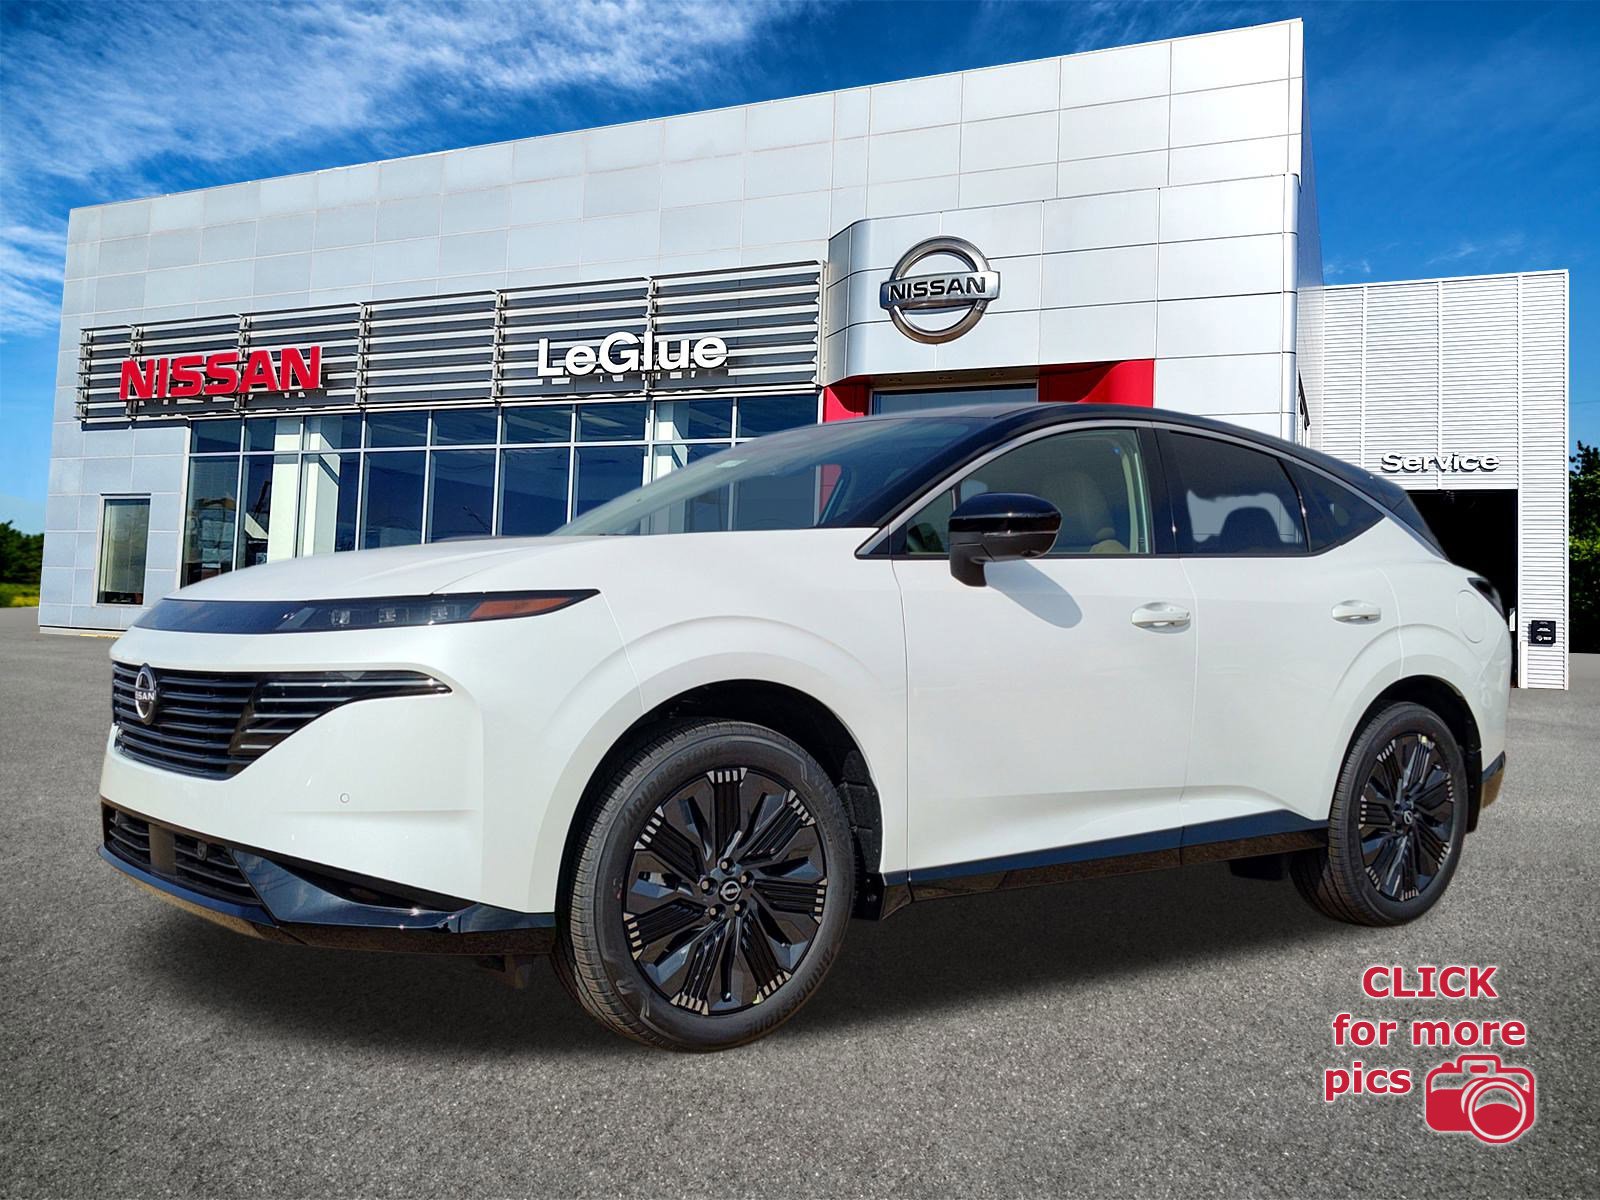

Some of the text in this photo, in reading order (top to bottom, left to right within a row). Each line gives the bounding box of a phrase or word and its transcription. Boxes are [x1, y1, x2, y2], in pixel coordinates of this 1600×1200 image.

[888, 276, 987, 302] NISSAN
[537, 331, 728, 377] LeGlue
[119, 345, 322, 400] NISSAN
[1381, 451, 1499, 473] Service
